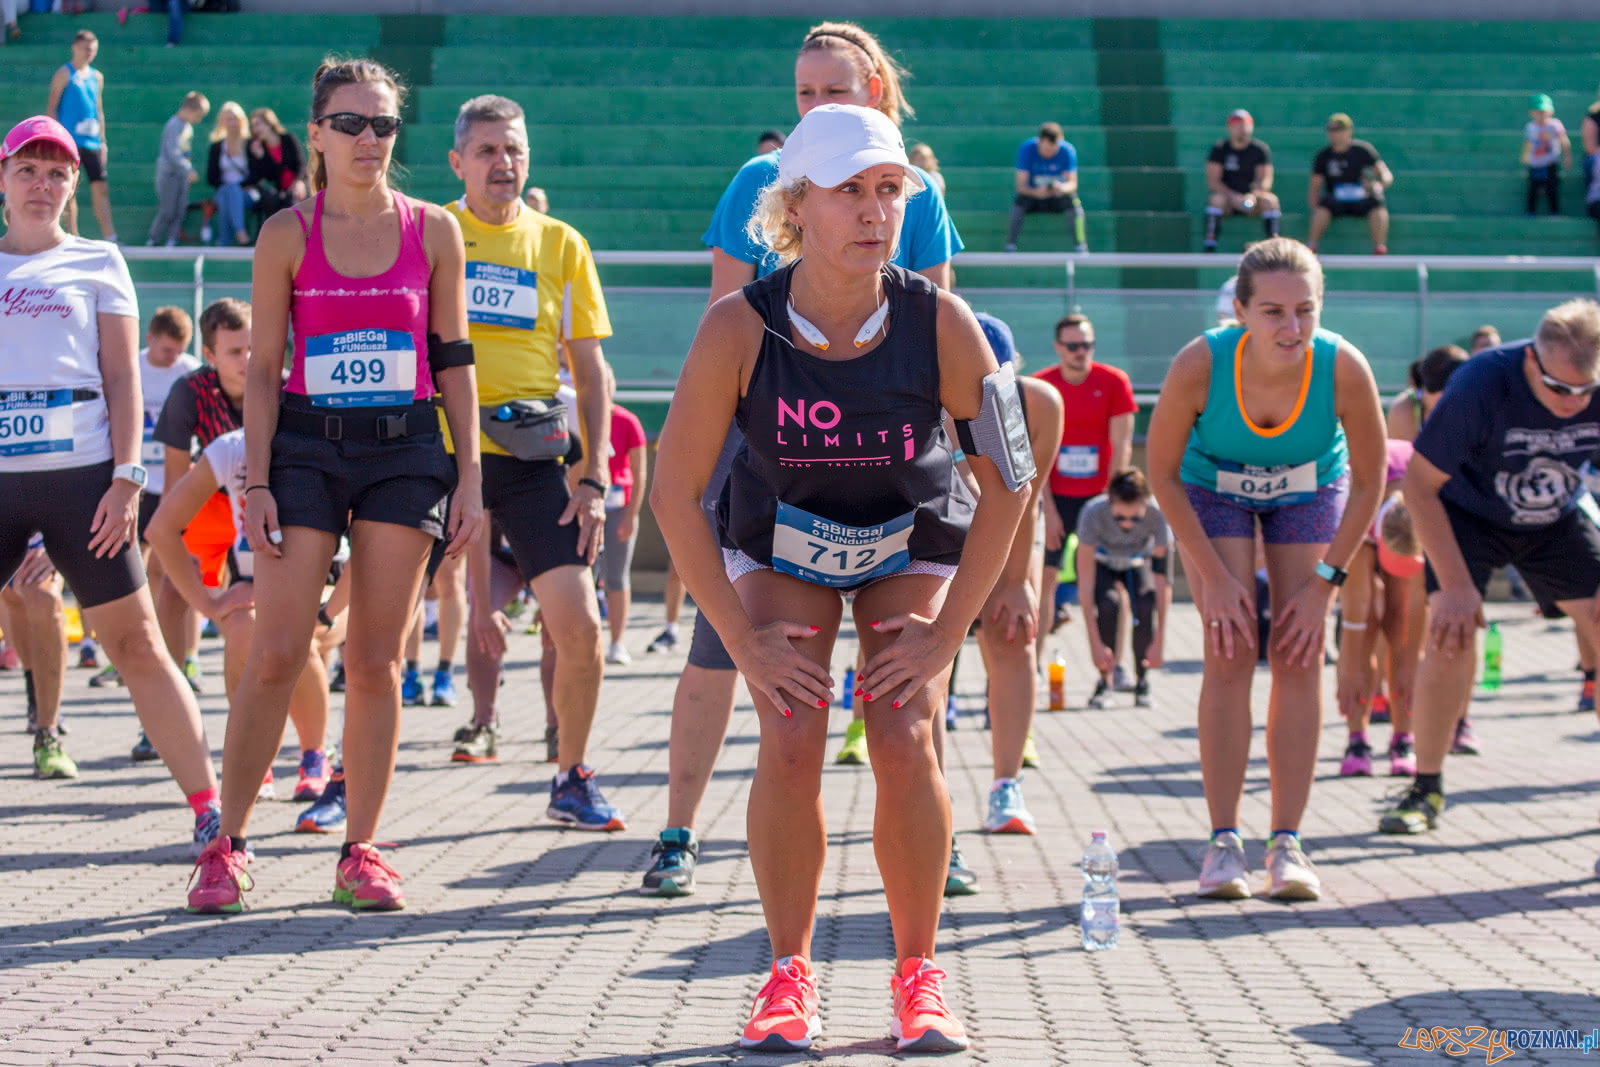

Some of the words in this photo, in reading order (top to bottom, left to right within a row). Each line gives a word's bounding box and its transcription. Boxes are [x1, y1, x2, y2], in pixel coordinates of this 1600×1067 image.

[0, 287, 57, 303] Mamy
[472, 286, 515, 308] 087
[333, 330, 387, 345] zaBIEGaj
[341, 343, 388, 353] FUNdusze
[331, 358, 385, 385] 499
[777, 396, 842, 430] NO
[0, 414, 43, 438] 500
[777, 423, 913, 447] LIMITS
[828, 460, 892, 468] TRAINING
[1241, 476, 1288, 494] 044
[812, 519, 884, 538] zaBIEGaj
[822, 532, 883, 545] FUNdusze
[808, 541, 876, 570] 712
